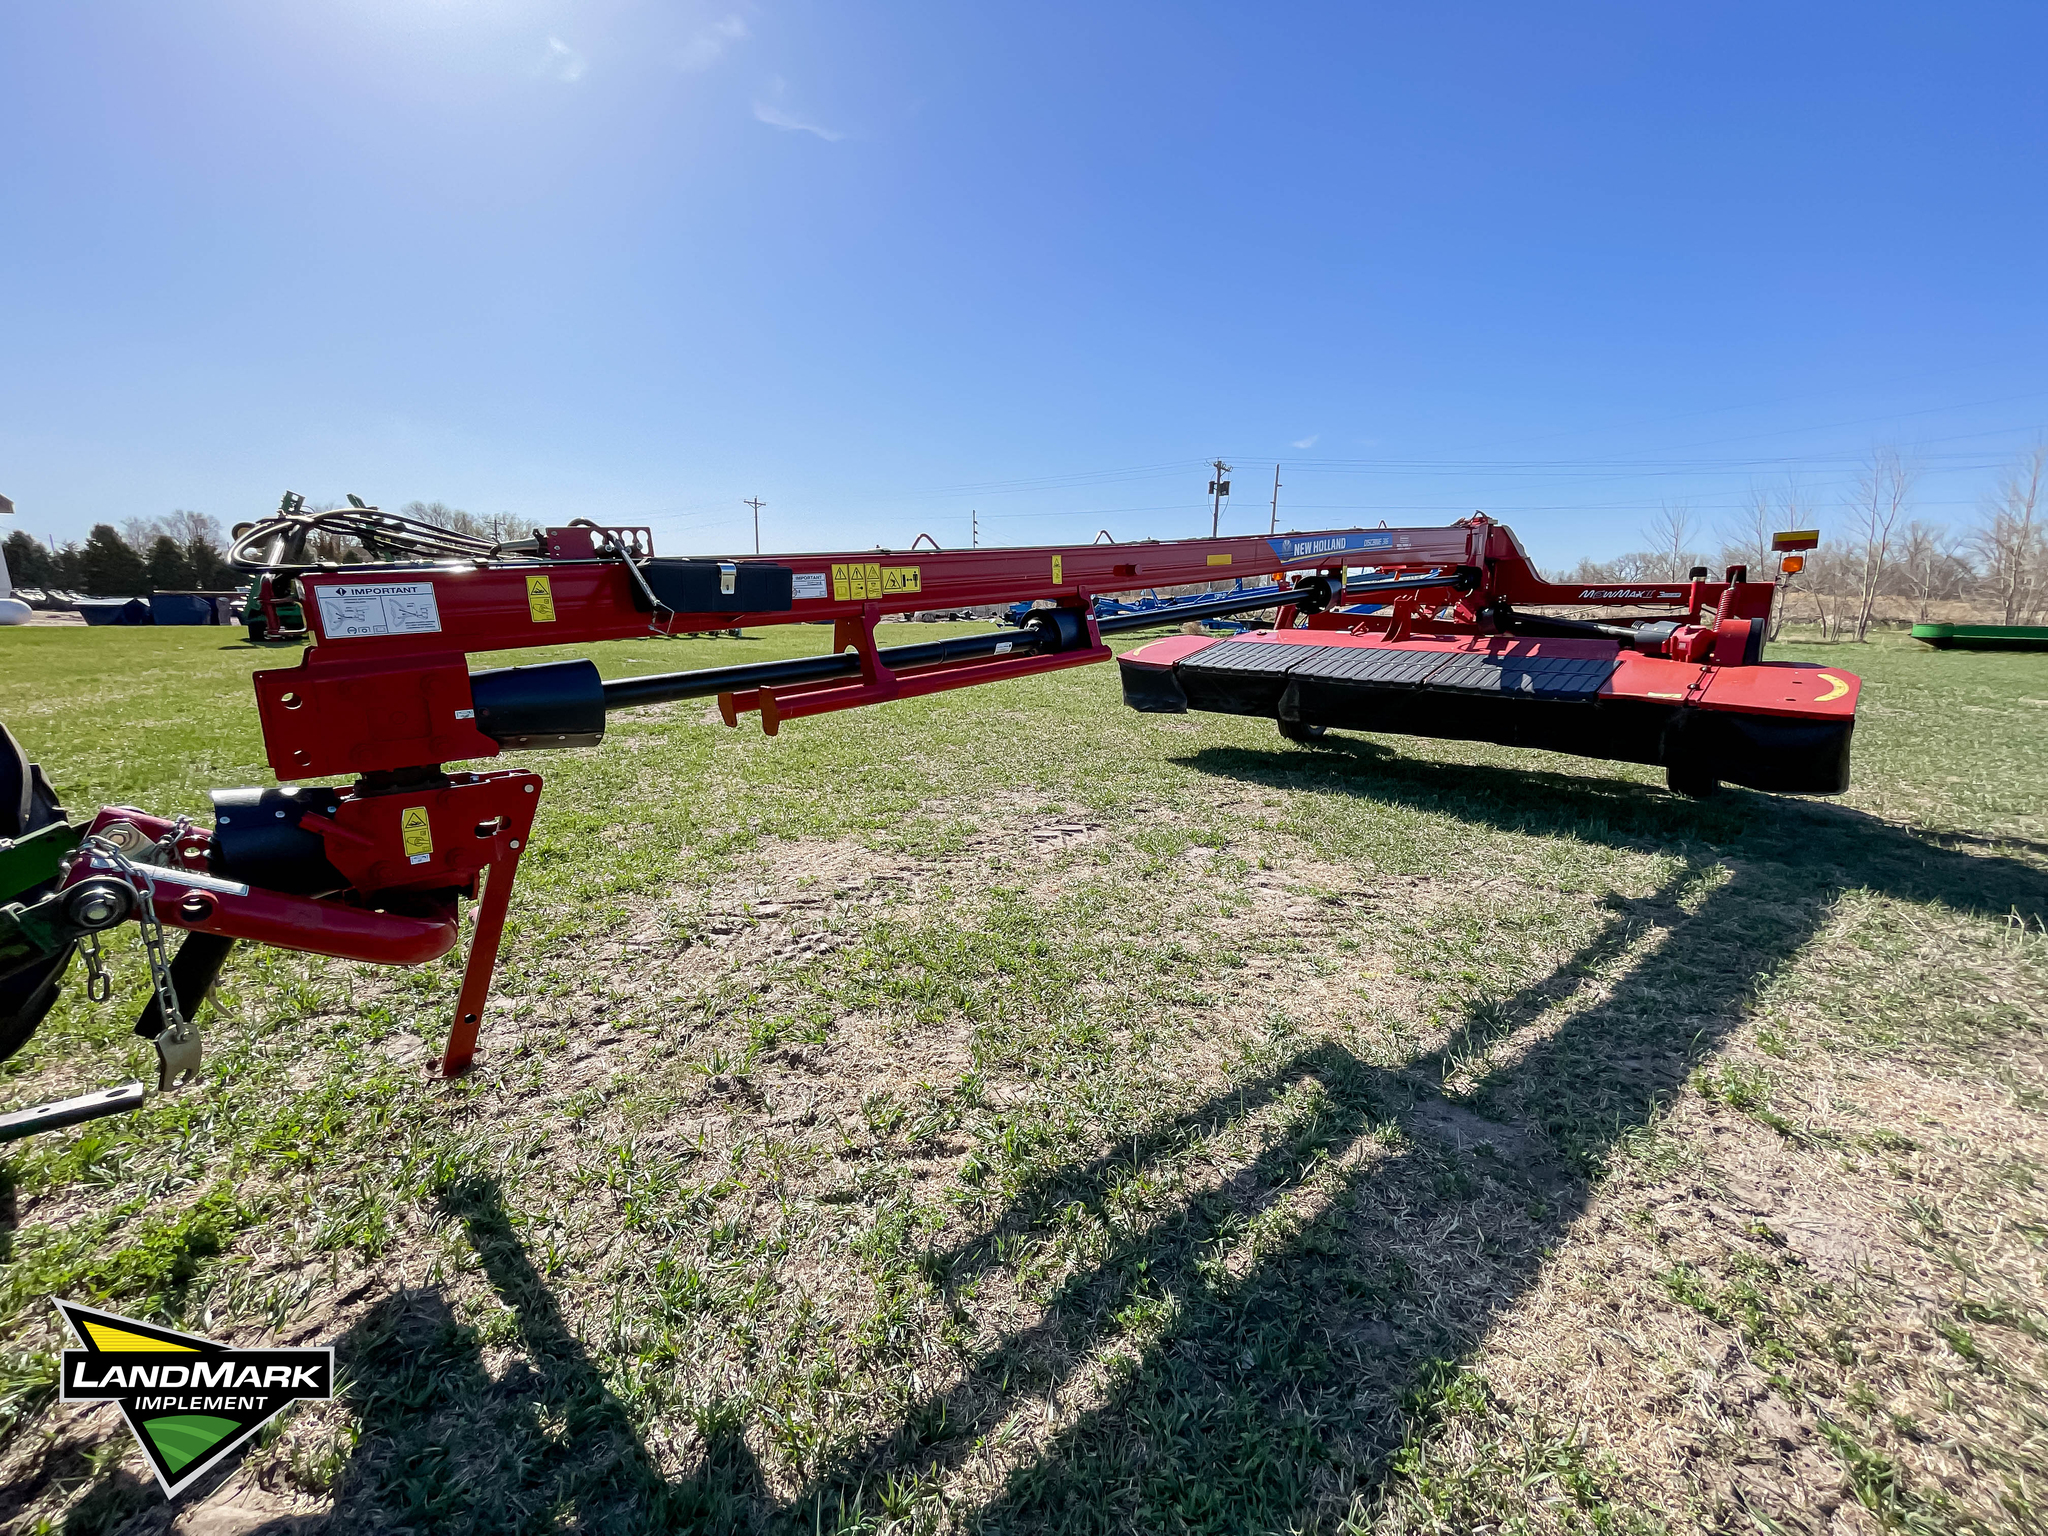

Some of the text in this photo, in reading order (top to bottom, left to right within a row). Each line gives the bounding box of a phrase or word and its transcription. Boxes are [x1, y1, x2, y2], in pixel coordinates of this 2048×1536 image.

[1294, 537, 1346, 556] NEW HOLLAND
[351, 586, 418, 595] IMPORTANT
